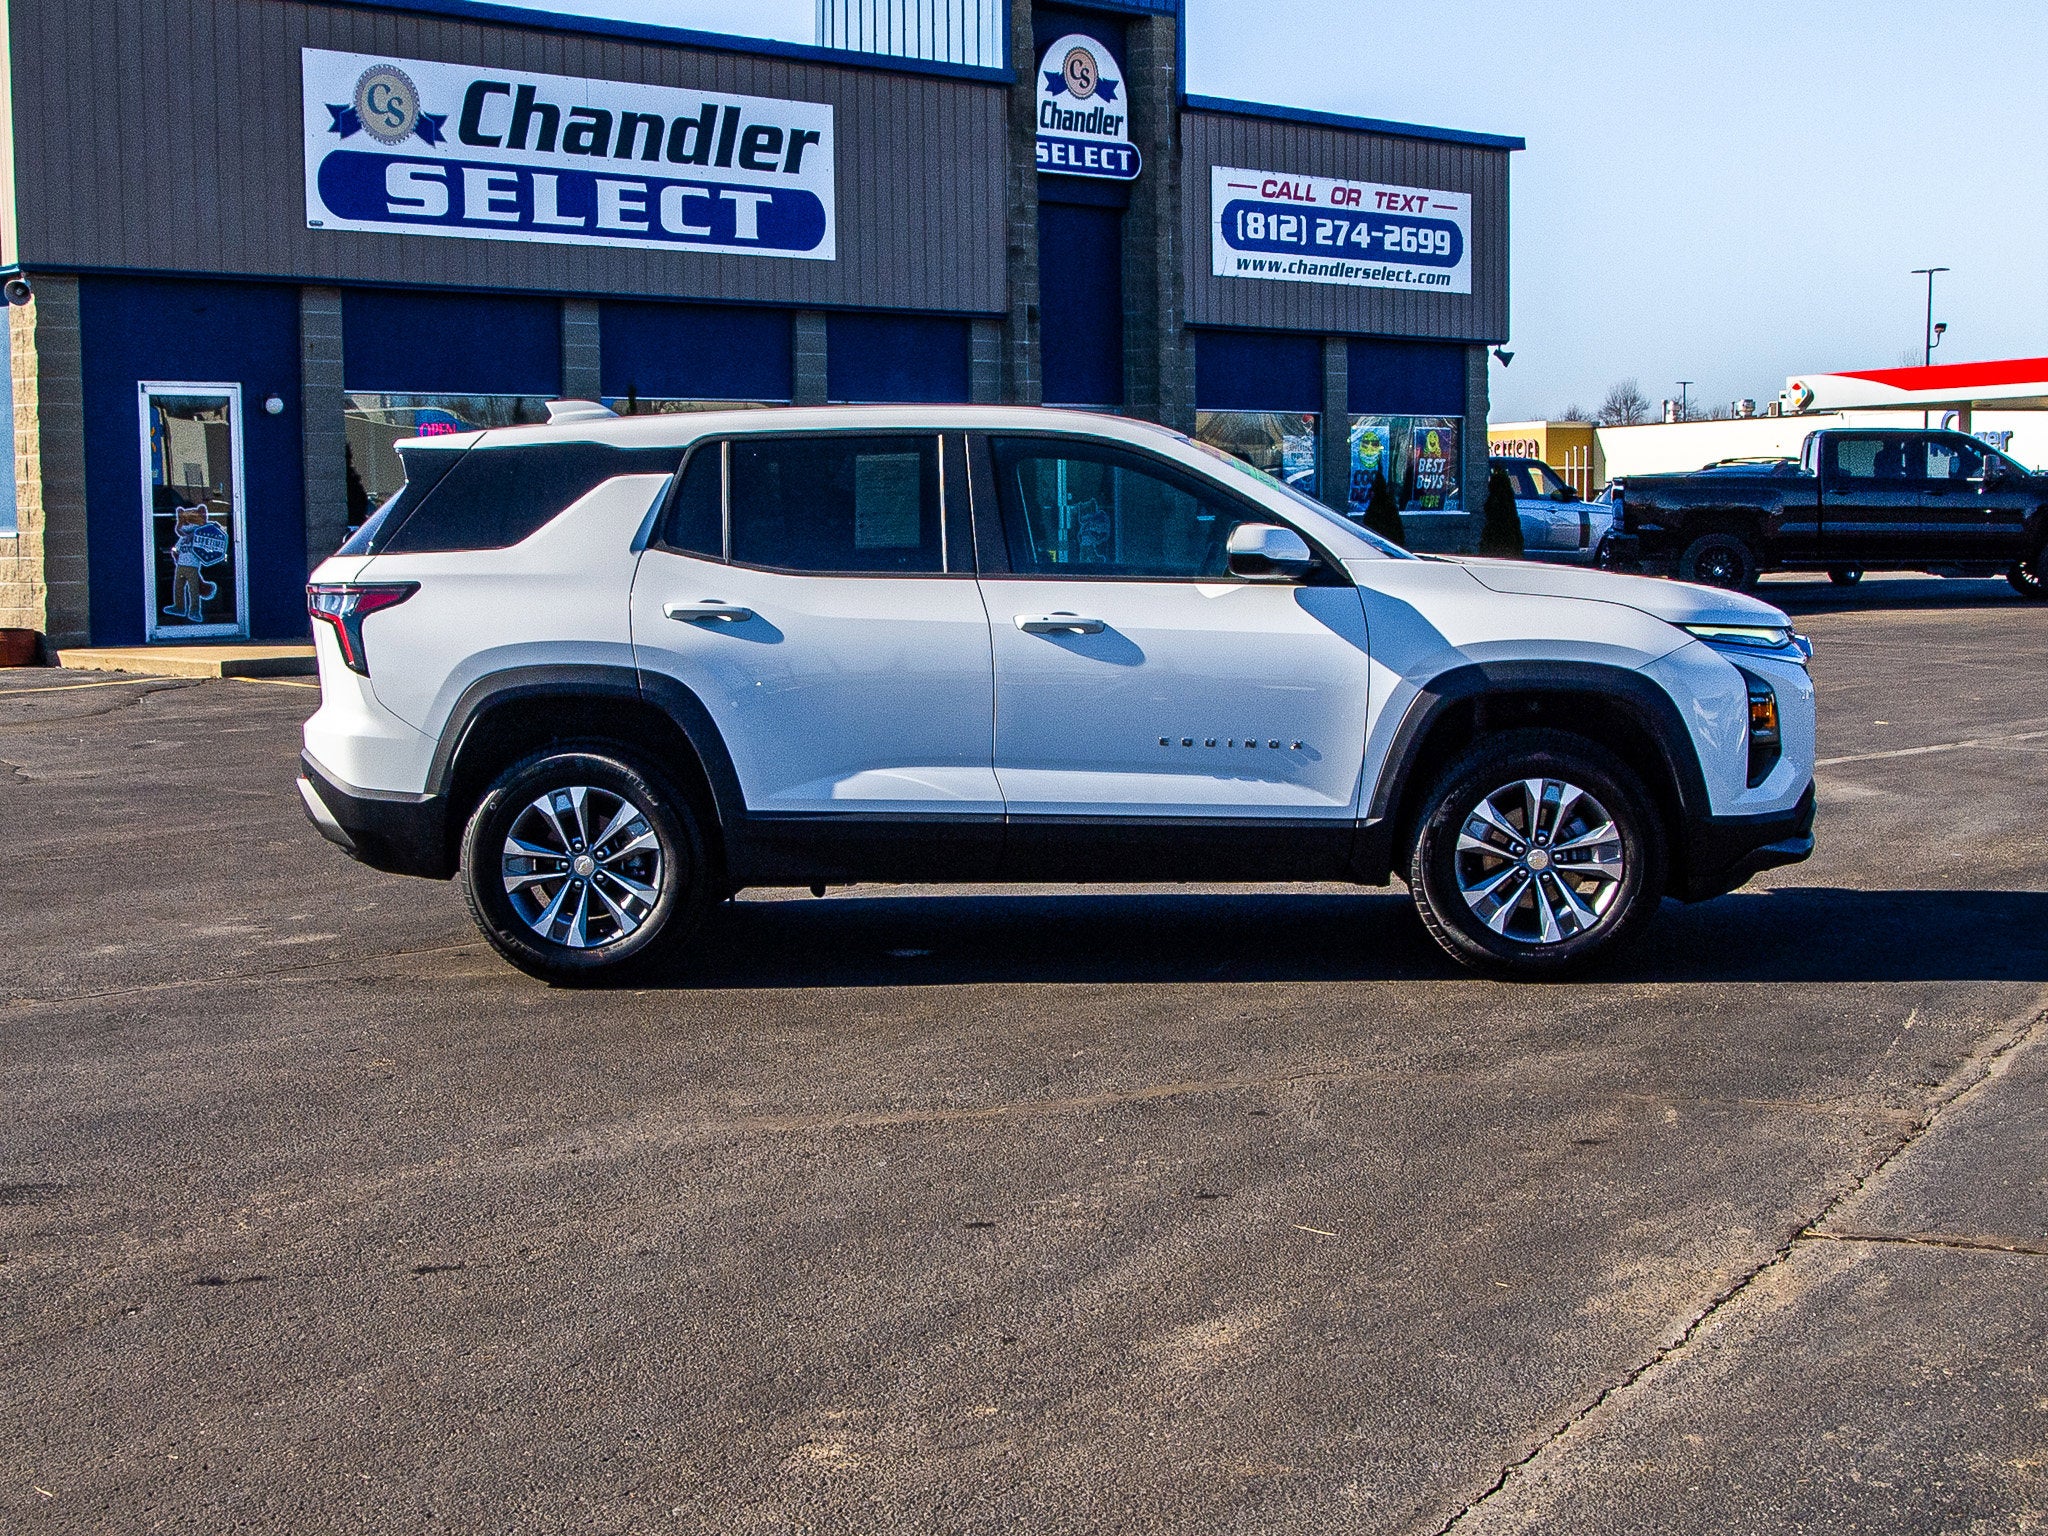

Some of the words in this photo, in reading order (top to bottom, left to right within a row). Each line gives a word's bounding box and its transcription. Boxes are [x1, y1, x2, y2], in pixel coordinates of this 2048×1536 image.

[367, 83, 405, 128] CS
[1039, 99, 1124, 137] Chandler
[457, 78, 821, 175] Chandler
[1036, 141, 1132, 171] SELECT
[384, 161, 774, 240] SELECT
[1261, 179, 1317, 203] CALL
[1330, 186, 1362, 207] OR
[1374, 191, 1429, 213] TEXT
[1236, 209, 1307, 246] (812)
[1315, 217, 1451, 257] 274-2699
[1236, 257, 1451, 286] www.chandlerselect.com
[419, 422, 456, 437] OPEN
[1418, 458, 1447, 473] BEST
[1158, 736, 1303, 750] EQUINOX
